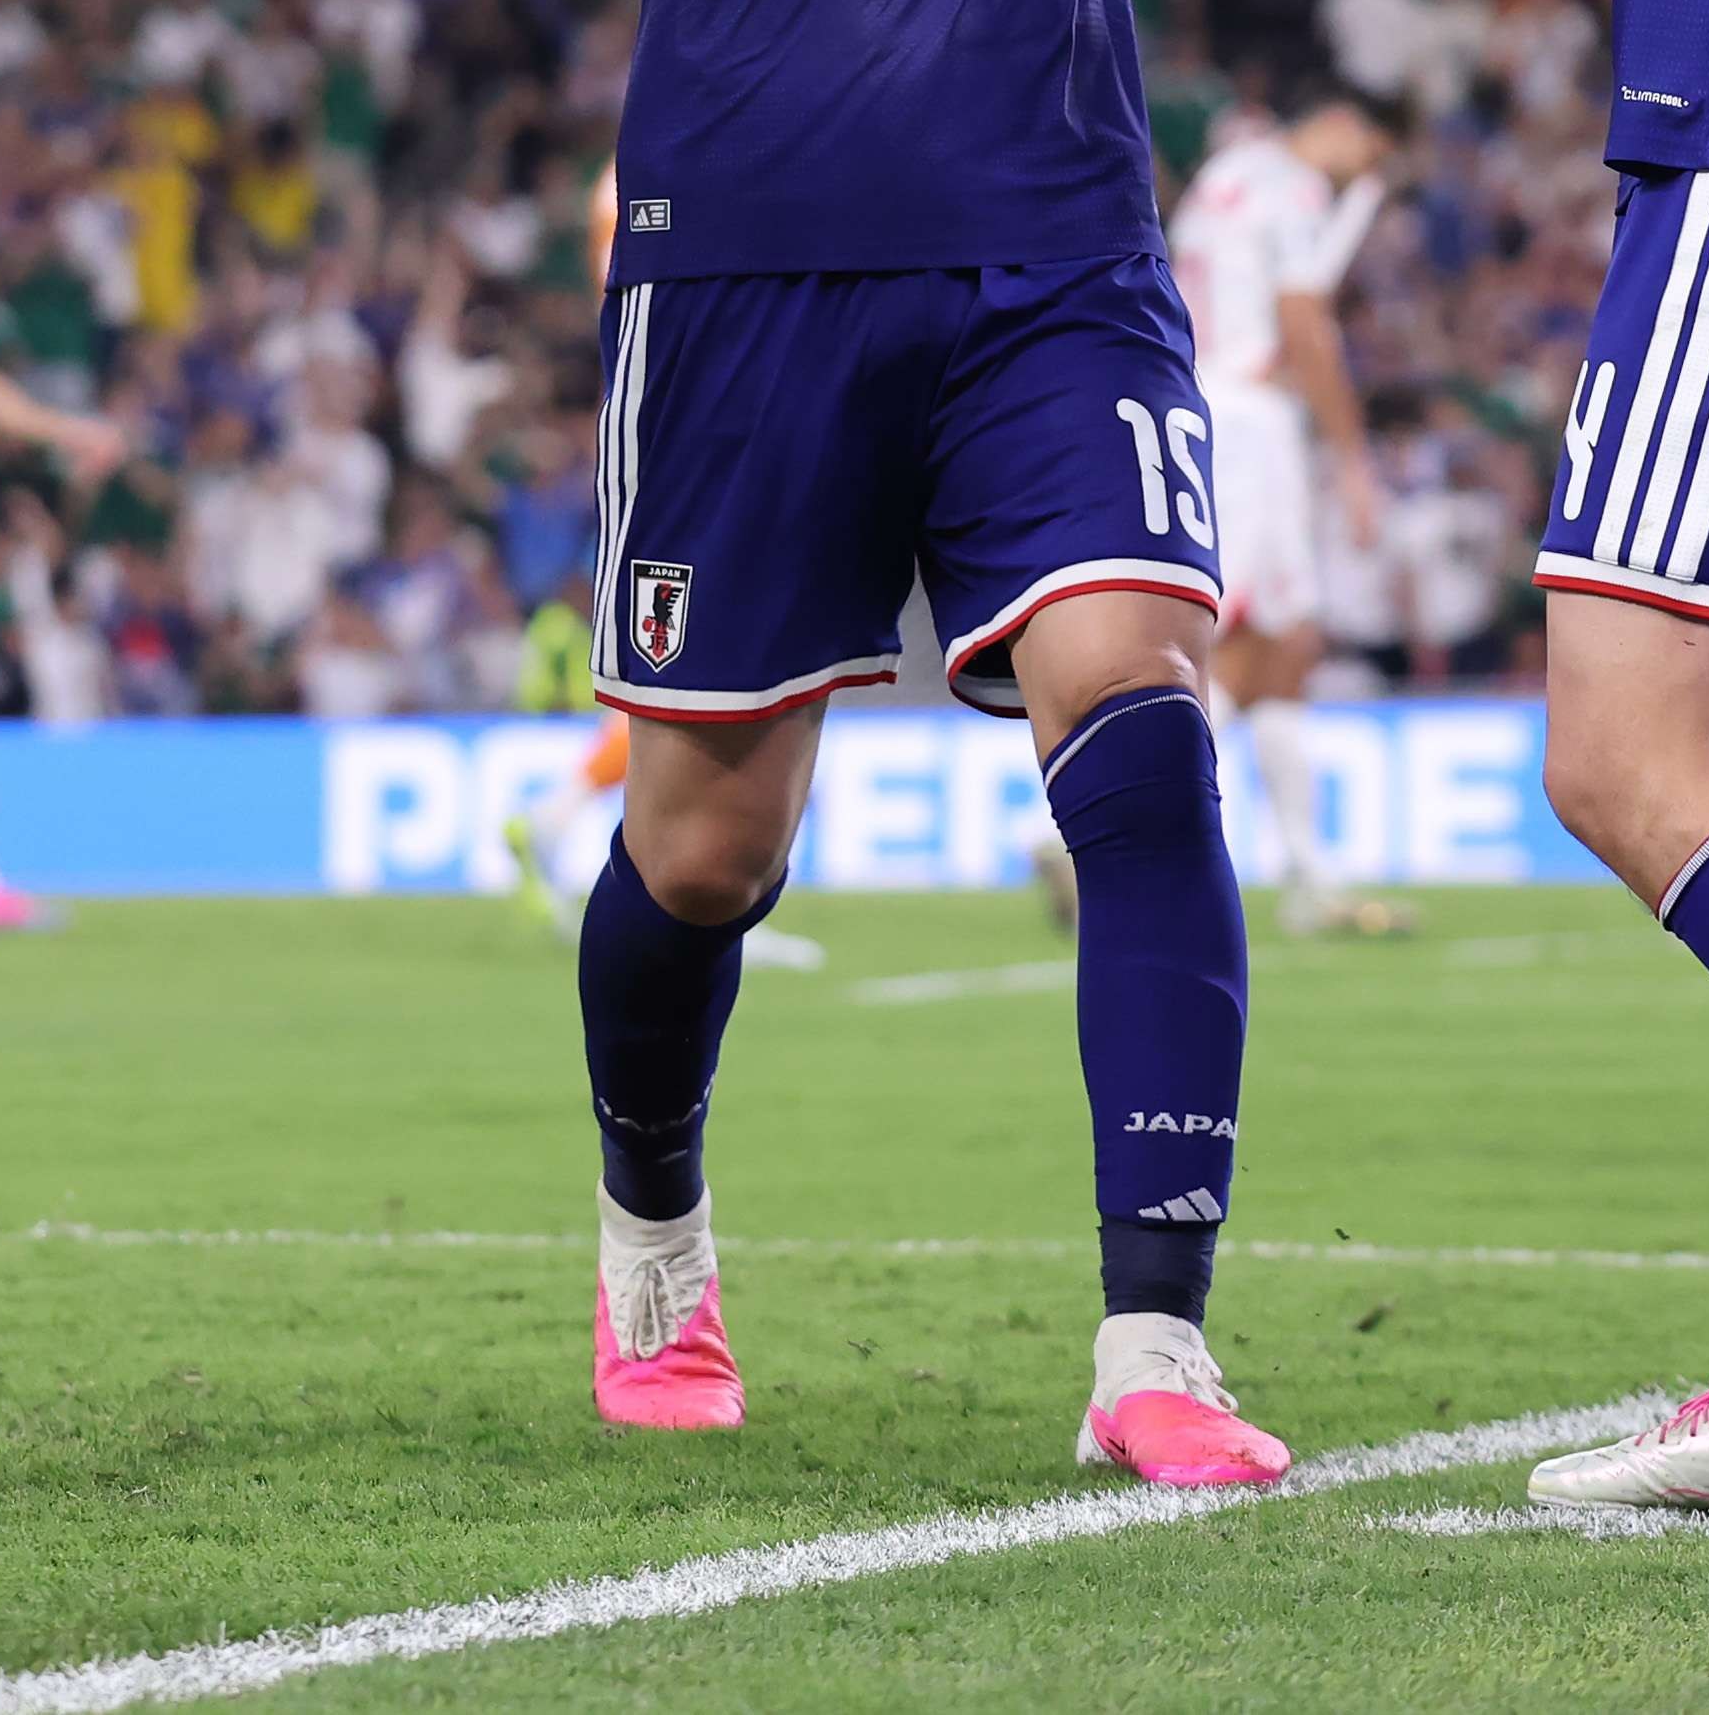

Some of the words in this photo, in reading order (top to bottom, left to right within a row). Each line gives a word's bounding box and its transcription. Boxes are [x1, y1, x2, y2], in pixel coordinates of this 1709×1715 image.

[1623, 90, 1683, 108] CLIMACOOL
[1116, 397, 1214, 550] 15
[648, 567, 681, 579] JAPAN
[1123, 1112, 1238, 1140] JAPA
